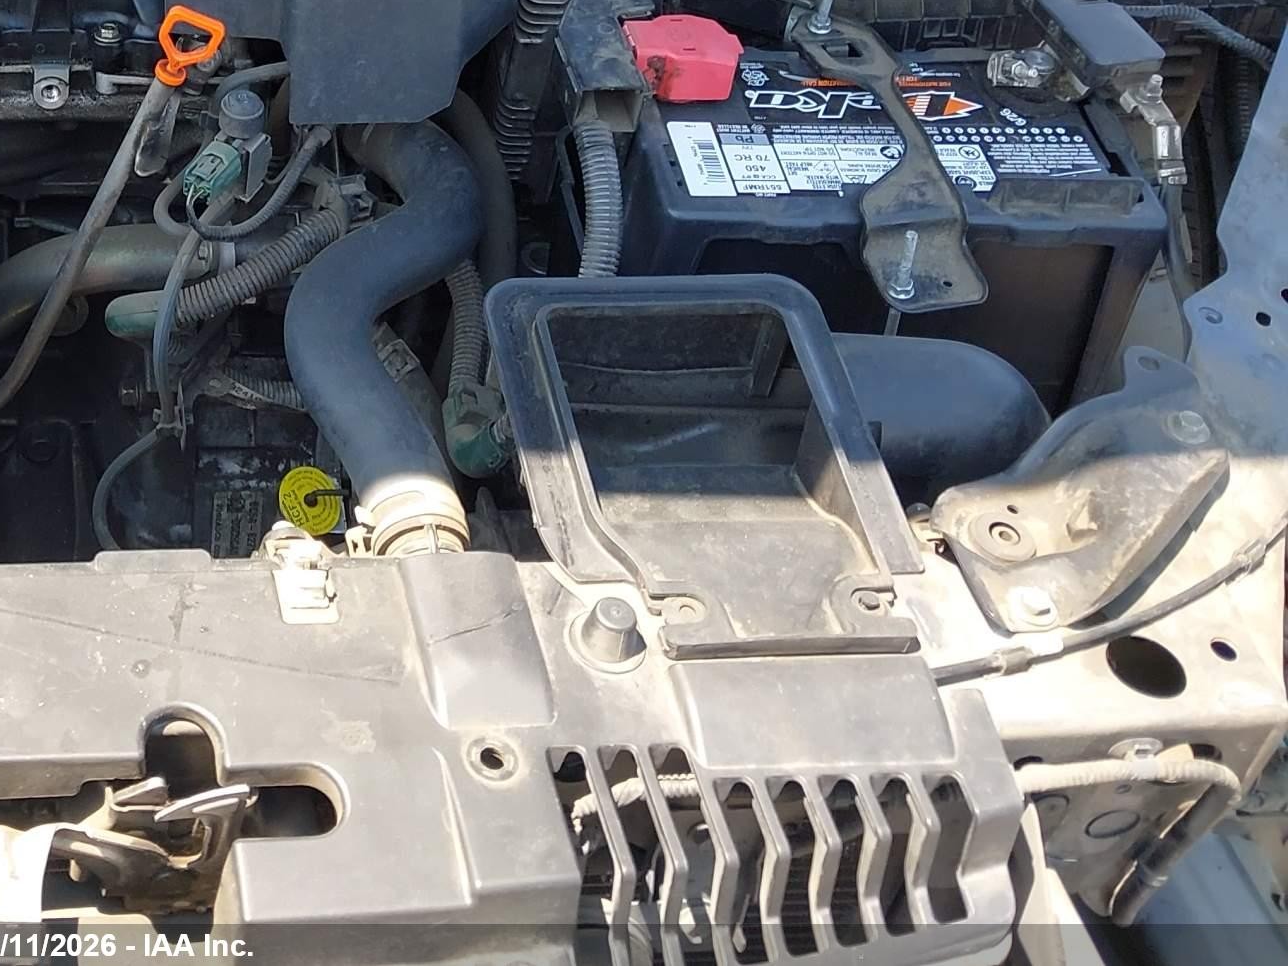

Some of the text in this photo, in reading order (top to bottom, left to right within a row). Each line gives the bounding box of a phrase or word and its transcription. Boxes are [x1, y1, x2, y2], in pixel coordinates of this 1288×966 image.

[999, 108, 1027, 126] 6/26
[735, 135, 754, 143] Pb
[745, 164, 766, 172] 450
[283, 491, 305, 527] HCF-2
